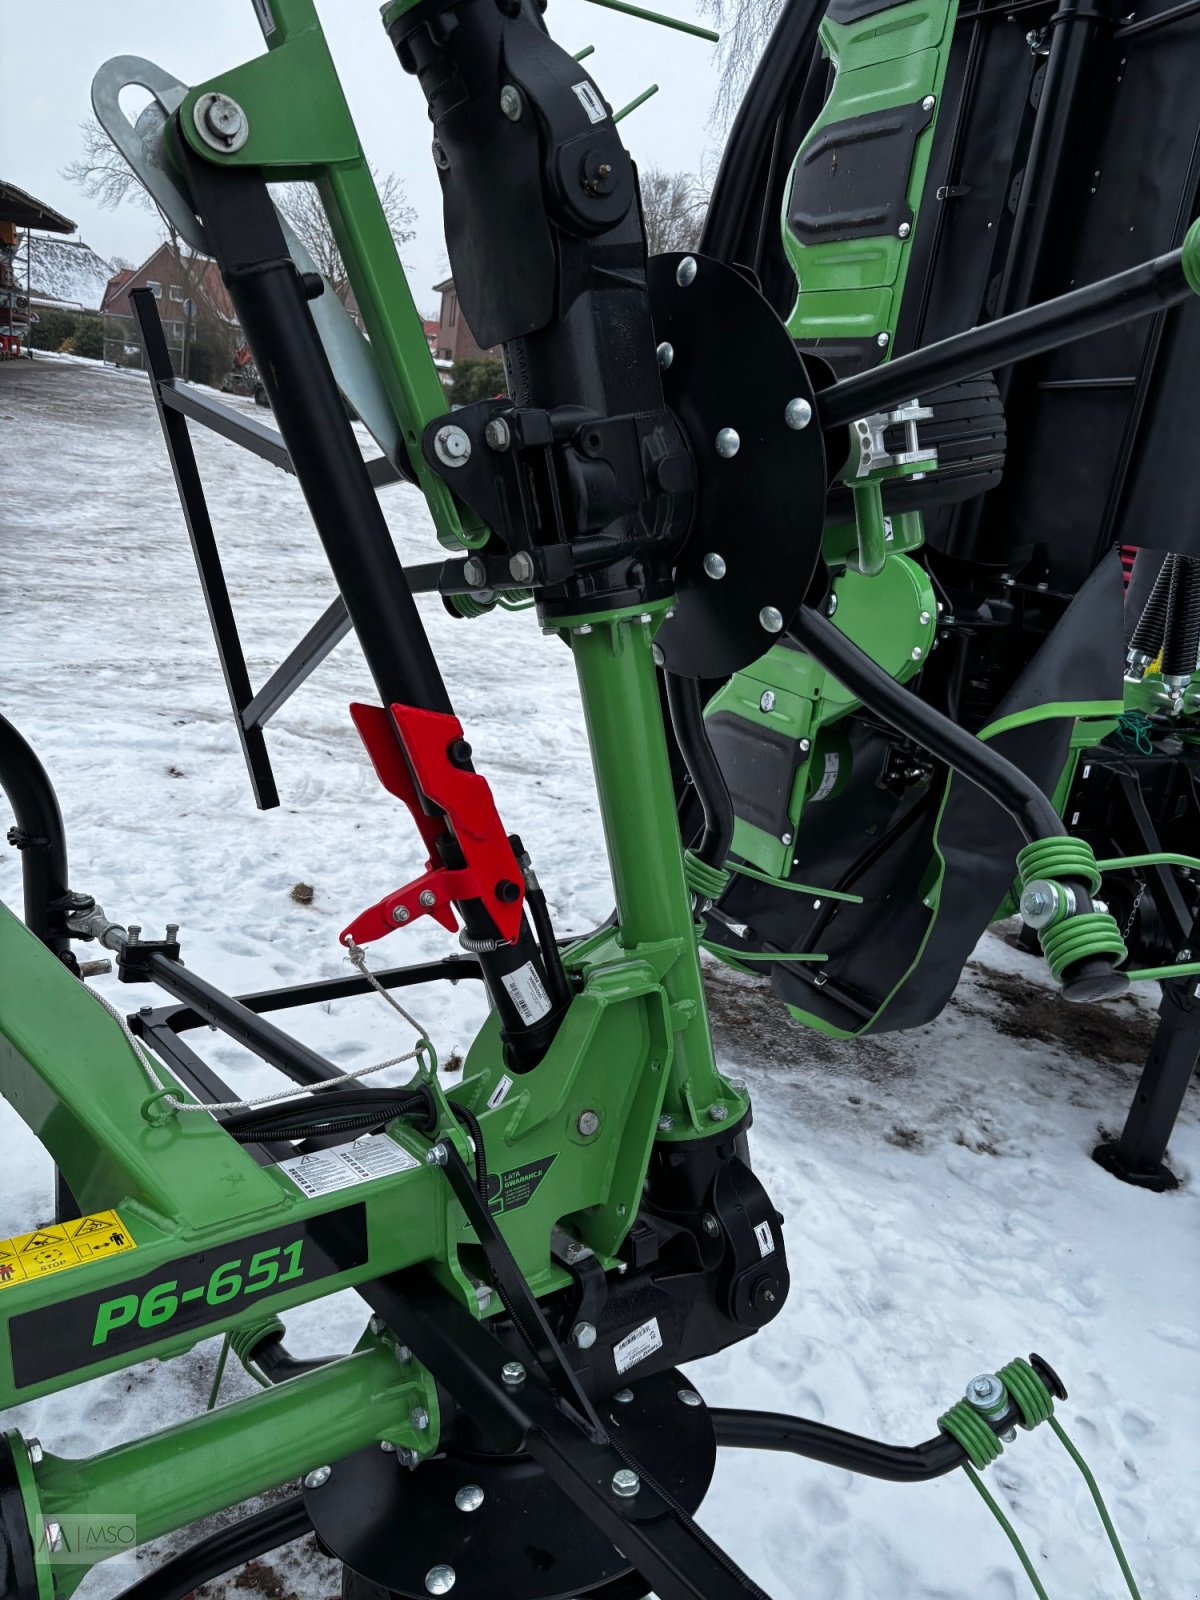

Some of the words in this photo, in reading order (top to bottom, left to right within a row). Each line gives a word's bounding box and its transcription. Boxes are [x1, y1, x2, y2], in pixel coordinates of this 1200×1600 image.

[504, 1171, 521, 1181] LATA
[504, 1169, 543, 1188] GWARANCJI
[40, 1260, 66, 1272] STOP
[92, 1240, 305, 1346] P6-651
